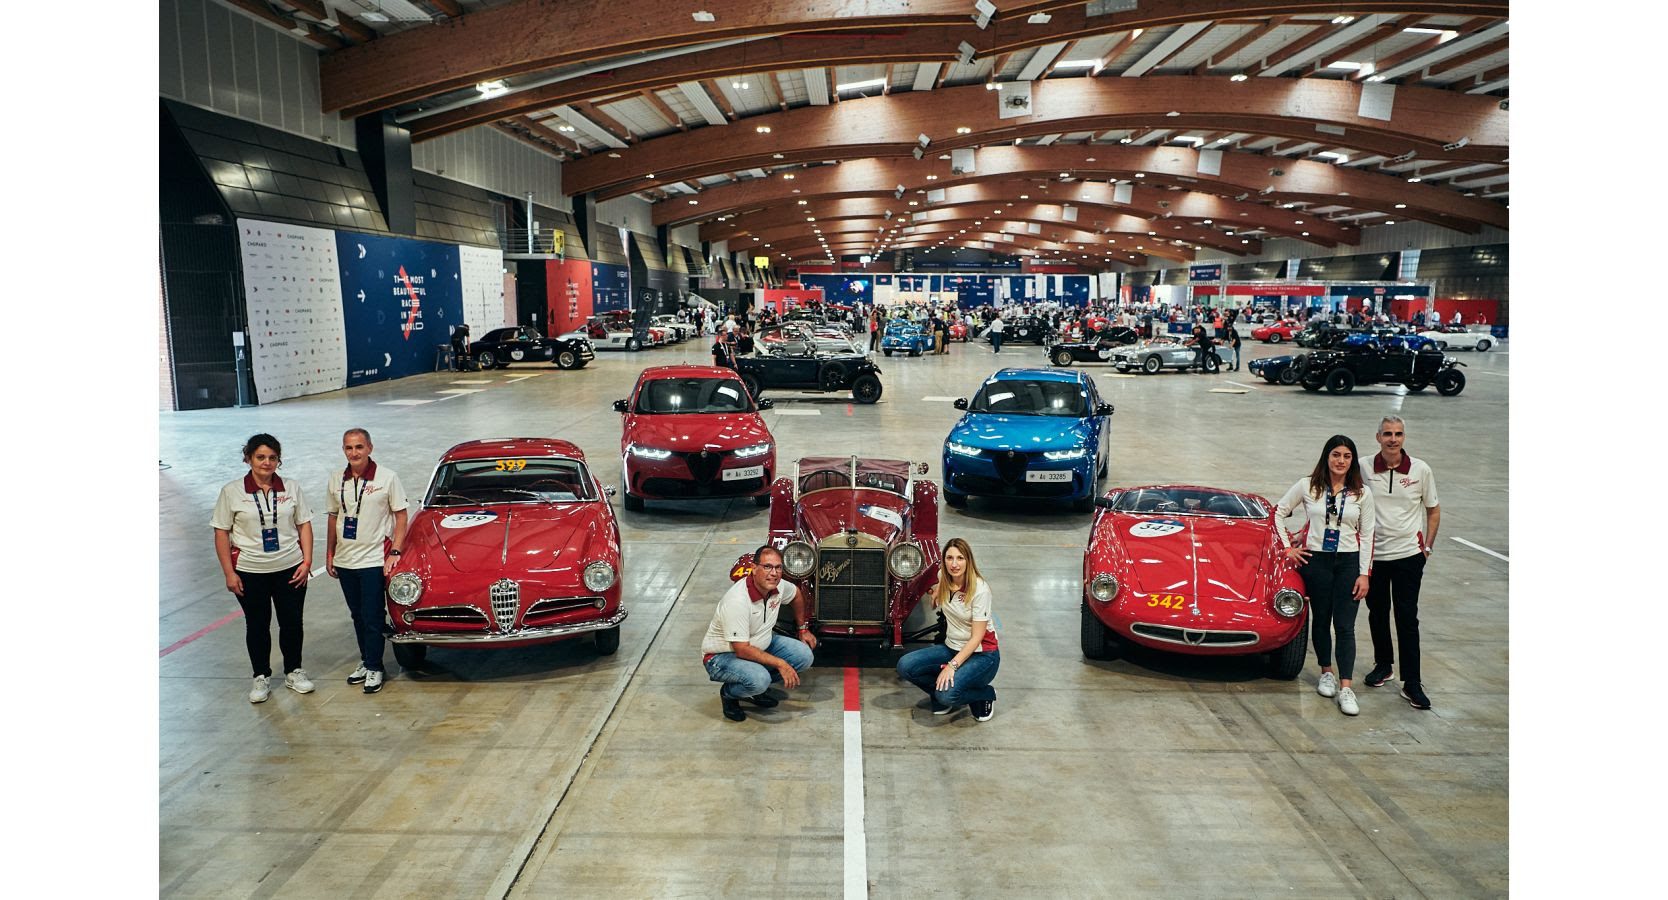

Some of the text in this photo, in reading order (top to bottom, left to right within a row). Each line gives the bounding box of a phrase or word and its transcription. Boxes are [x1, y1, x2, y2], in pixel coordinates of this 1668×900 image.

[393, 275, 424, 284] THE MOST
[393, 287, 426, 296] BEAUTIFUL
[401, 299, 420, 308] RACE
[401, 311, 422, 319] IN THE
[401, 322, 424, 331] WORLD
[495, 459, 527, 471] 399
[1140, 523, 1175, 532] 342
[1147, 594, 1185, 610] 342
